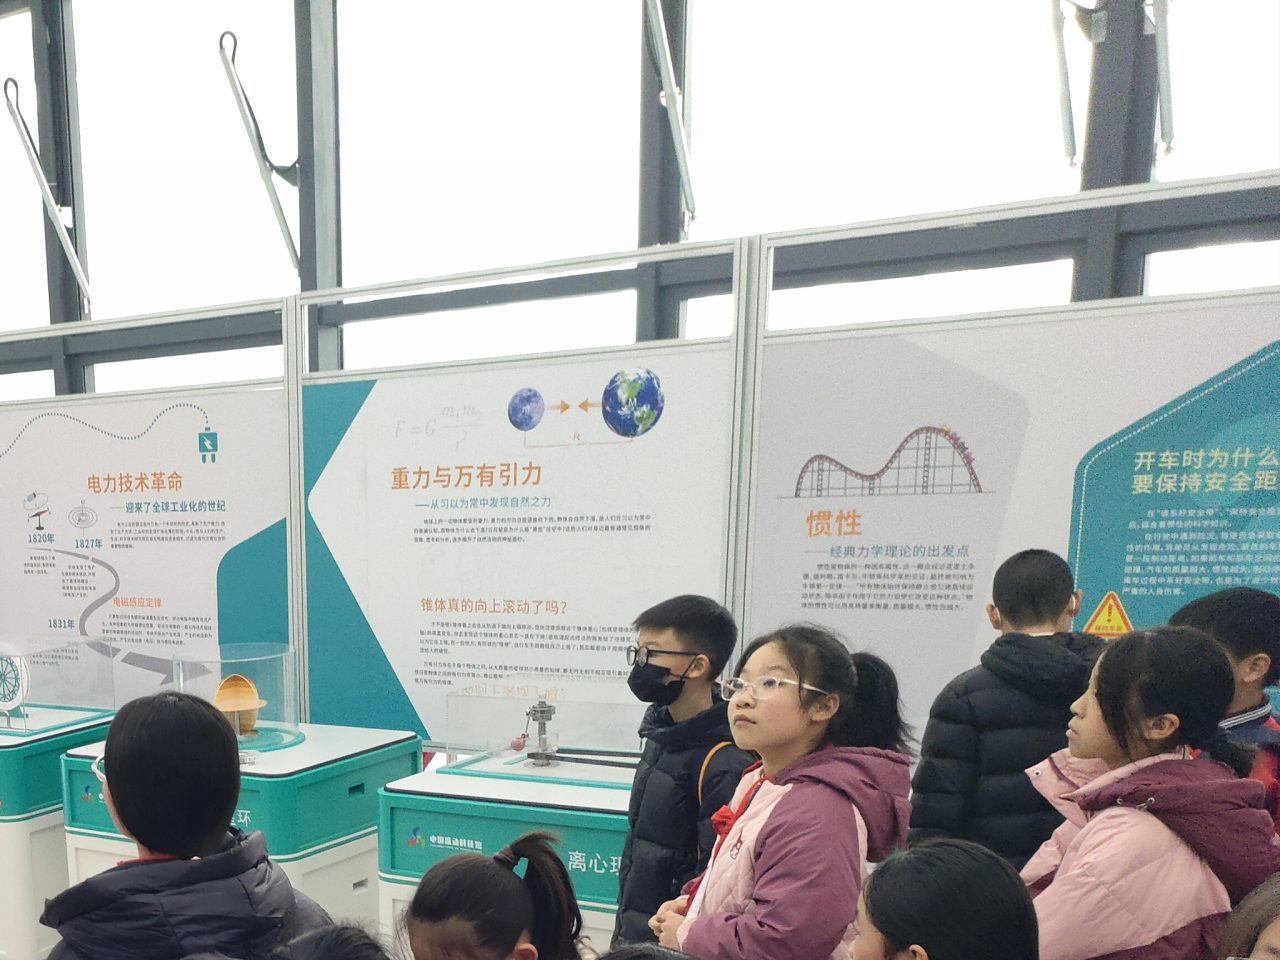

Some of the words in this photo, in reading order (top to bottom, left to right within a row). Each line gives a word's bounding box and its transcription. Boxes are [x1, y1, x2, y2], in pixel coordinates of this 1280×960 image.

[1134, 446, 1280, 471] 开车时为什么
[87, 471, 183, 494] 电力技术革命
[391, 461, 542, 490] 重力与万有引力
[1132, 470, 1279, 495] 要保持安全距
[805, 509, 863, 538] 惯性
[28, 532, 55, 544] 1820年
[74, 538, 103, 550] 1827年
[113, 596, 163, 609] 电磁感应定律
[48, 618, 76, 630] 1831年
